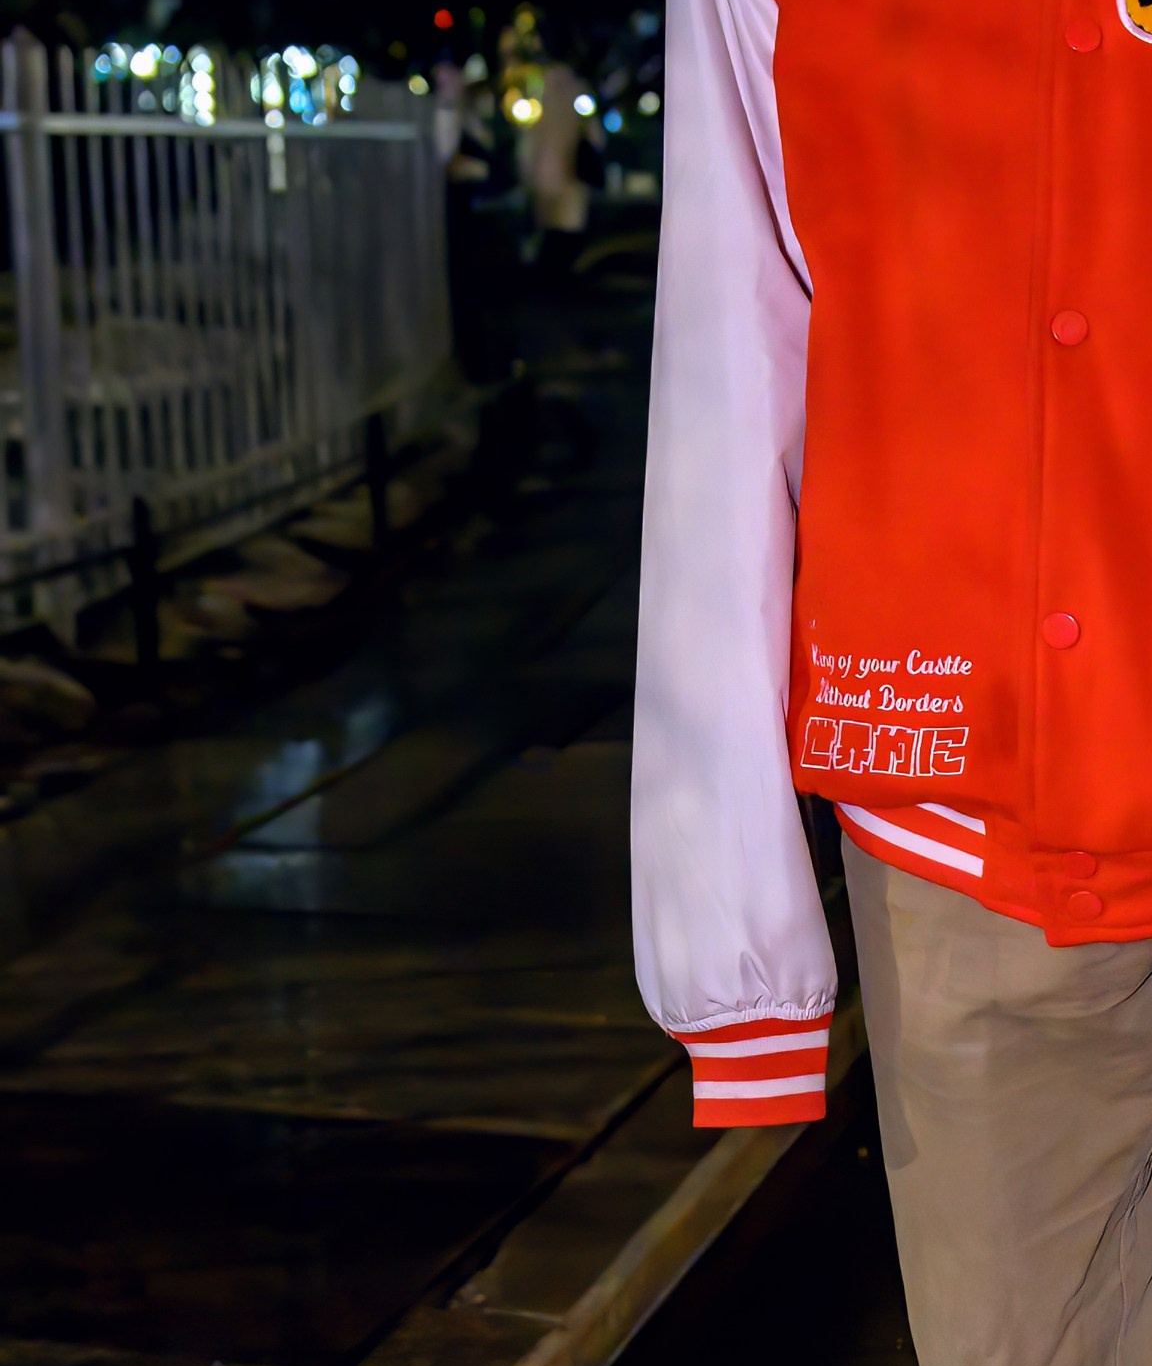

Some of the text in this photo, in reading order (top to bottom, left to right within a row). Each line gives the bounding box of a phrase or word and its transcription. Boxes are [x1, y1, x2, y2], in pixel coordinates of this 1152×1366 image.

[838, 655, 852, 678] of
[855, 658, 900, 678] your
[906, 649, 972, 676] Castle
[877, 684, 964, 713] Borders
